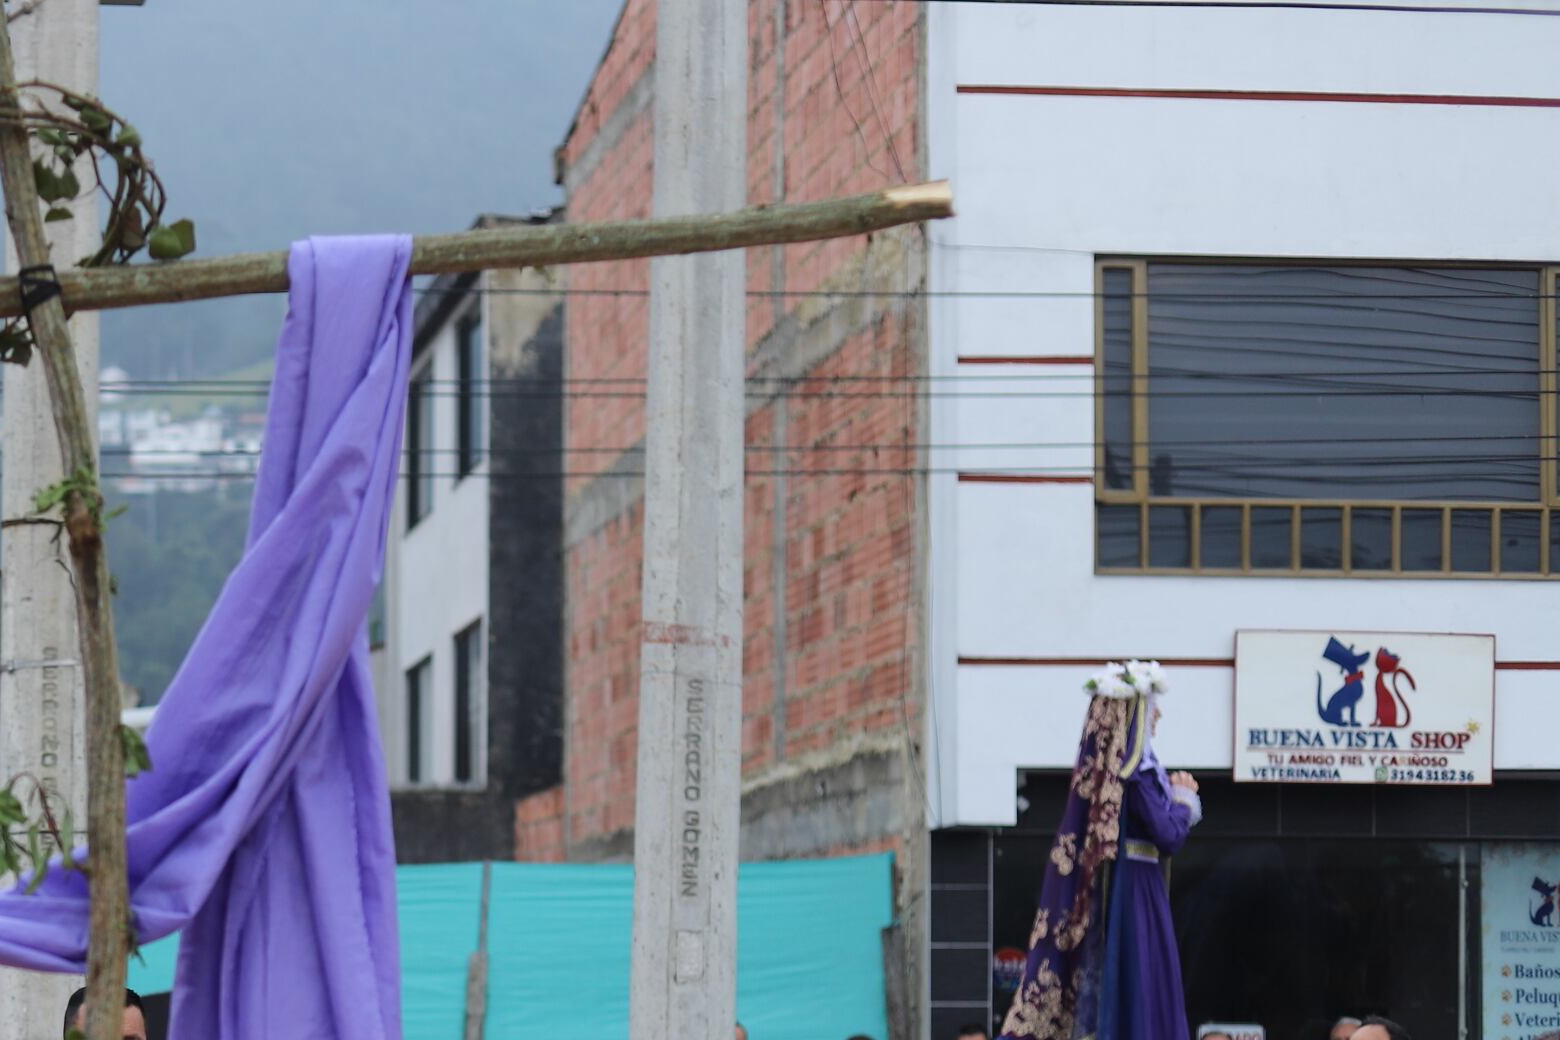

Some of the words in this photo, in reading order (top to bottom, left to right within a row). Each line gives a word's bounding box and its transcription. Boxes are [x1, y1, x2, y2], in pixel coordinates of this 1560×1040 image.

[684, 678, 704, 802] SERRANO
[1248, 729, 1325, 747] BUENA
[1331, 730, 1399, 749] VISTA
[1410, 731, 1471, 750] SHOP
[1267, 754, 1284, 765] TU
[1288, 754, 1335, 766] AMIGO
[1340, 755, 1364, 766] FIEL
[1369, 755, 1377, 766] Y
[1381, 753, 1448, 767] CAIÑOSO
[1251, 767, 1341, 779] VETERINARIA
[681, 810, 701, 897] GOMEZ
[1515, 987, 1560, 1008] Peluq
